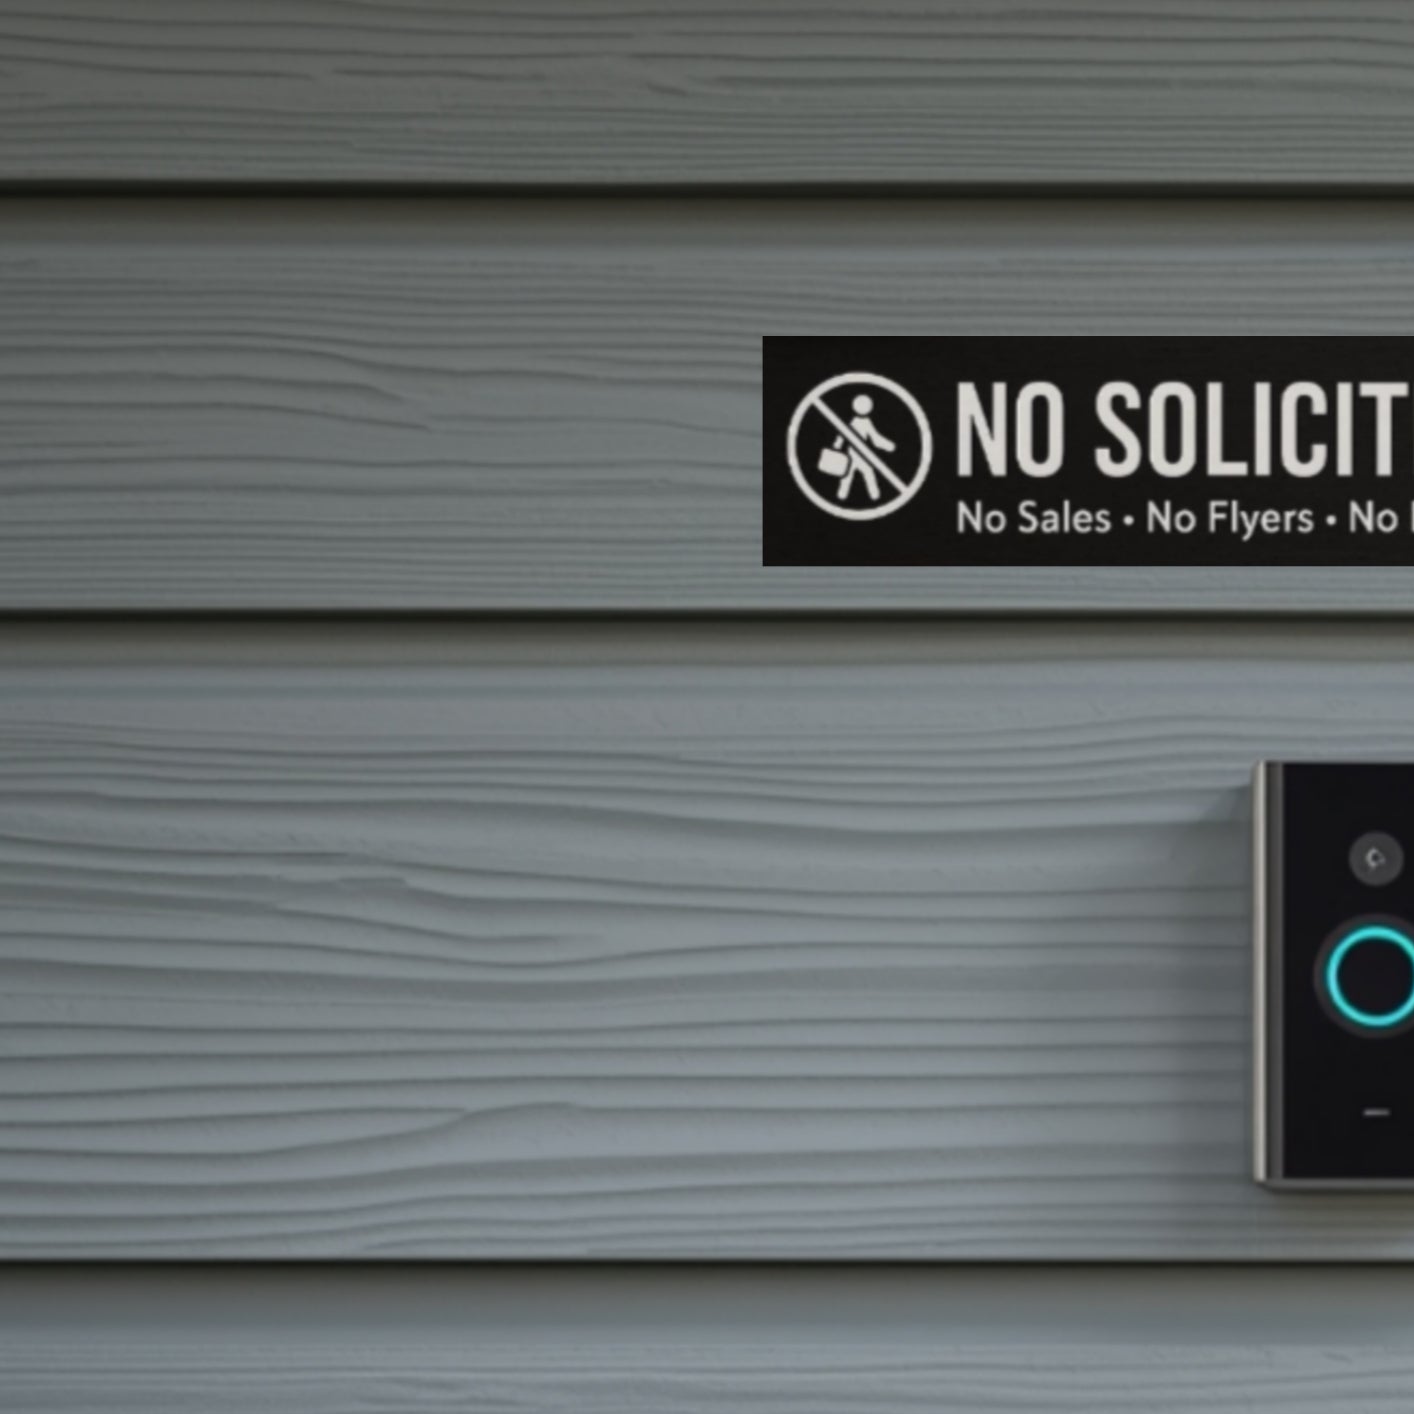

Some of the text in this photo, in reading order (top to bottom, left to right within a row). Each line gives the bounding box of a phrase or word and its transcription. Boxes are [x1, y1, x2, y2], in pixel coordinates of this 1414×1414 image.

[957, 381, 1063, 477] NO
[958, 500, 1005, 532] No
[1018, 499, 1110, 532] Sales
[1147, 500, 1195, 532] No
[1209, 500, 1313, 540] Flyers
[1350, 500, 1397, 532] No
